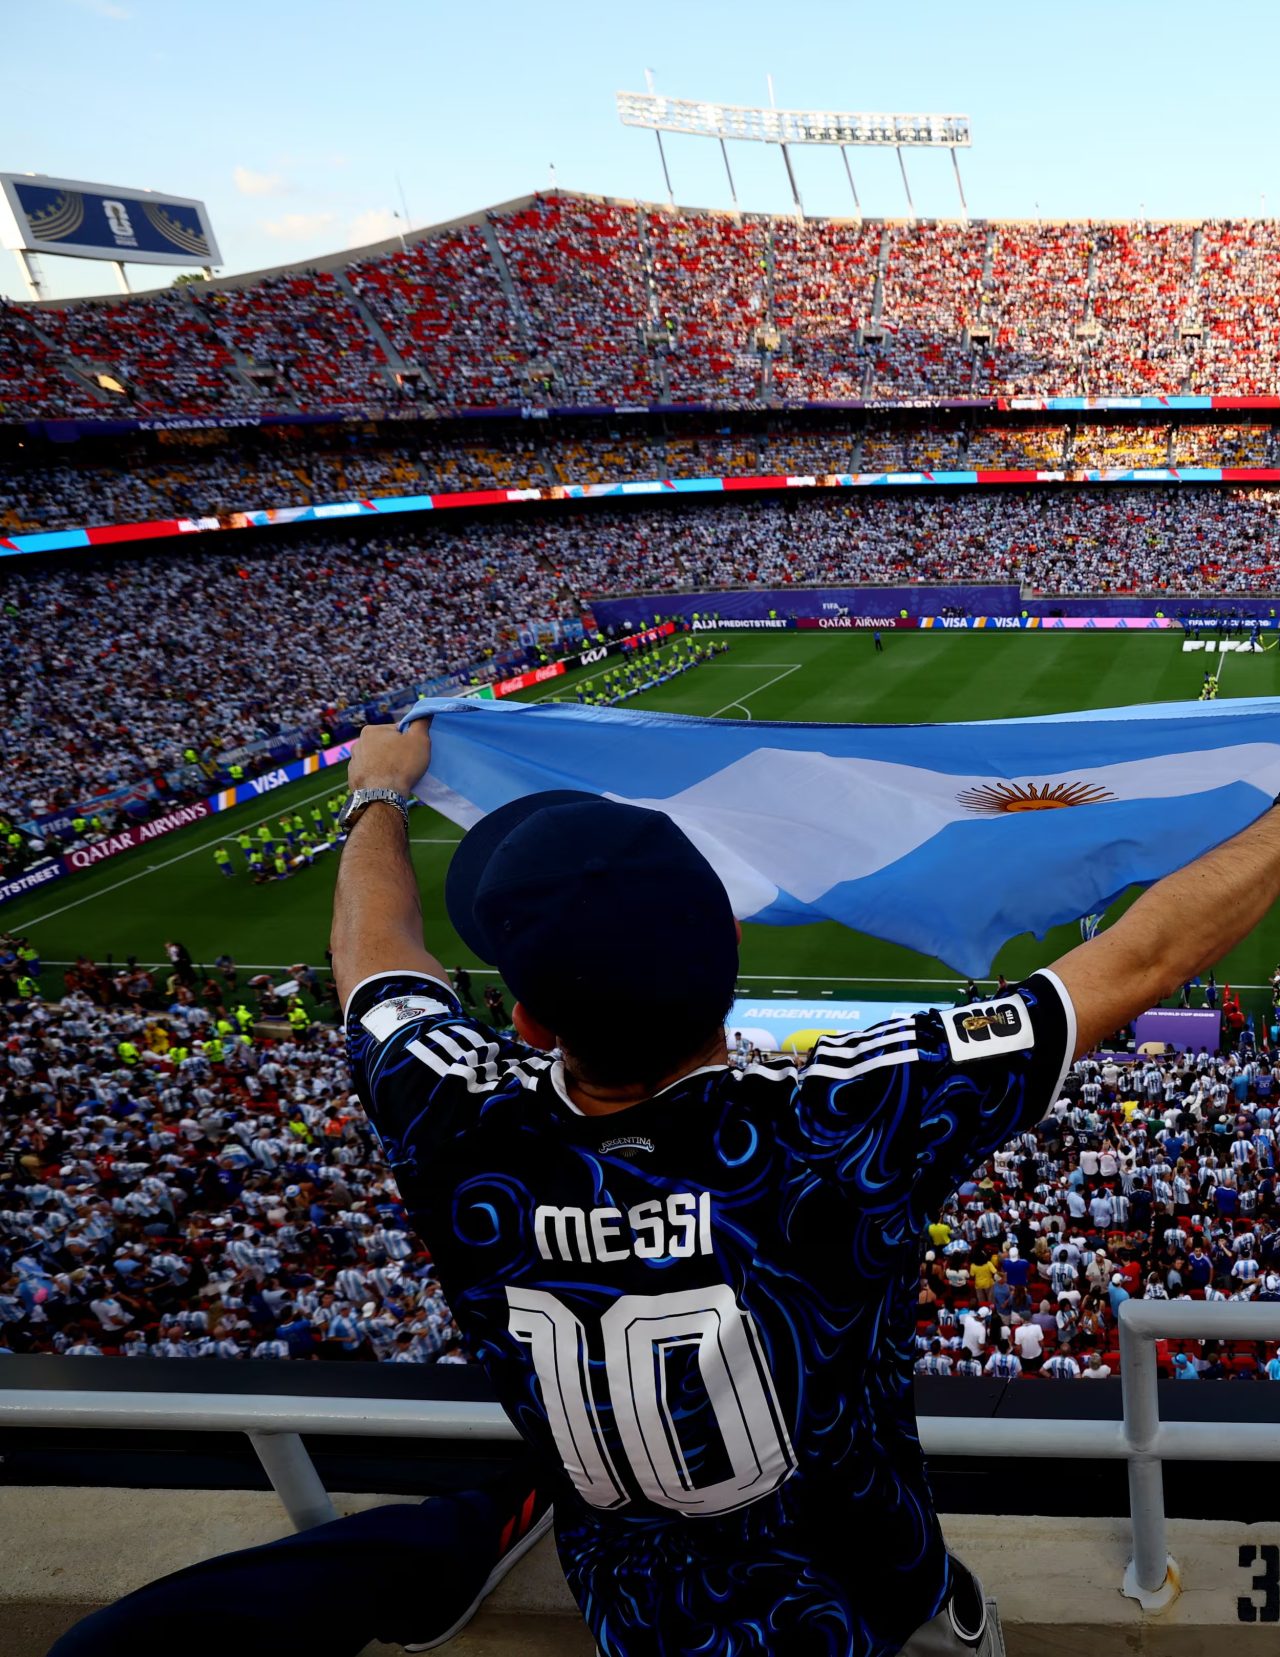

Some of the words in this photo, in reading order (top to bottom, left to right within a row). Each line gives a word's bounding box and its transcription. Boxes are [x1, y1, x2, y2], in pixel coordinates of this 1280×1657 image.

[864, 399, 912, 409] KANSAS
[139, 419, 217, 431] KANSAS
[219, 417, 262, 429] CITY
[822, 602, 840, 611] FIFA
[718, 619, 787, 628] PREDICTSTREET
[818, 618, 852, 628] QATAR
[855, 618, 896, 627] AIRWAYS
[942, 617, 968, 628] VISA
[994, 617, 1021, 628] VISA
[1182, 640, 1264, 653] FIFA
[250, 768, 291, 795] VISA
[40, 816, 73, 836] FIFA
[71, 832, 136, 868] QATAR
[139, 802, 208, 841] AIRWAYS
[743, 1007, 861, 1020] ARGENTINA
[1004, 1009, 1016, 1025] FIFA
[600, 1136, 653, 1150] ARGENTINA
[1078, 1134, 1088, 1145] 10
[534, 1191, 714, 1264] MESSI
[504, 1283, 800, 1518] 10
